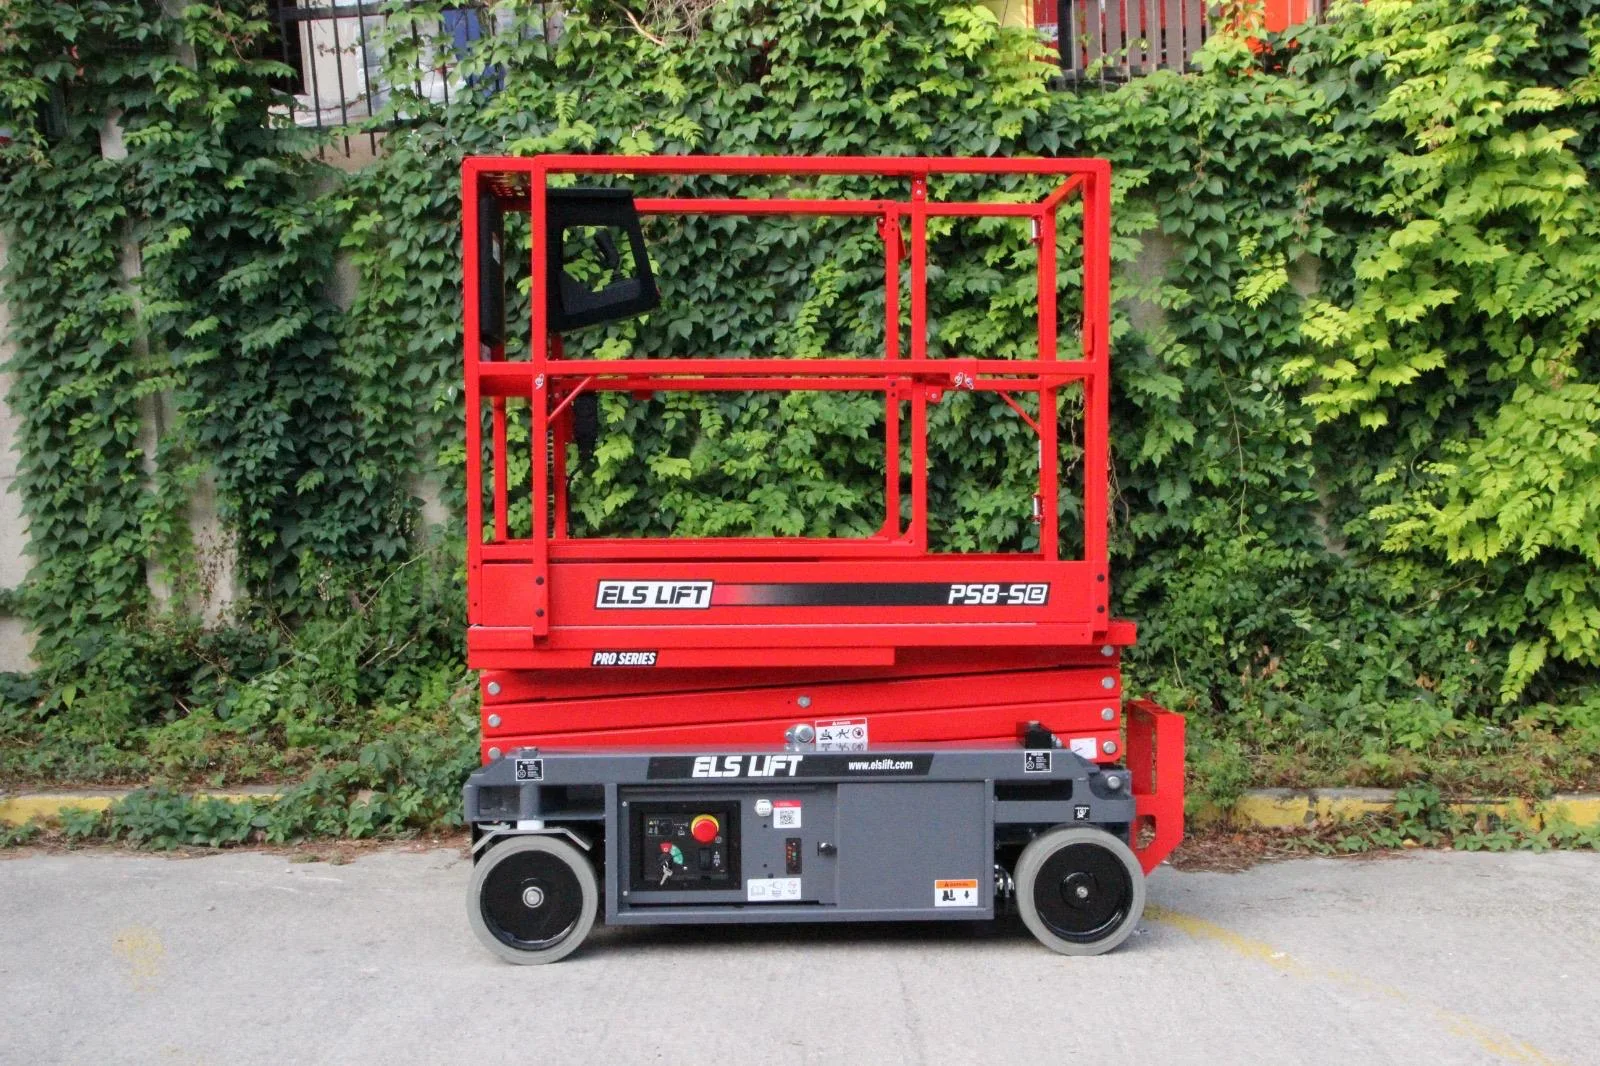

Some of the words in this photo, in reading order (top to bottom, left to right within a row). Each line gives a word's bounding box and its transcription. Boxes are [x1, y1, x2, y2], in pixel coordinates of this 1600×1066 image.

[600, 585, 649, 605] ELS
[655, 585, 708, 605] LIFT
[592, 652, 618, 665] PRO
[617, 652, 657, 665] SERIES
[692, 755, 743, 778] ELS
[747, 755, 804, 777] LIFT
[848, 758, 913, 770] www.elslift.com
